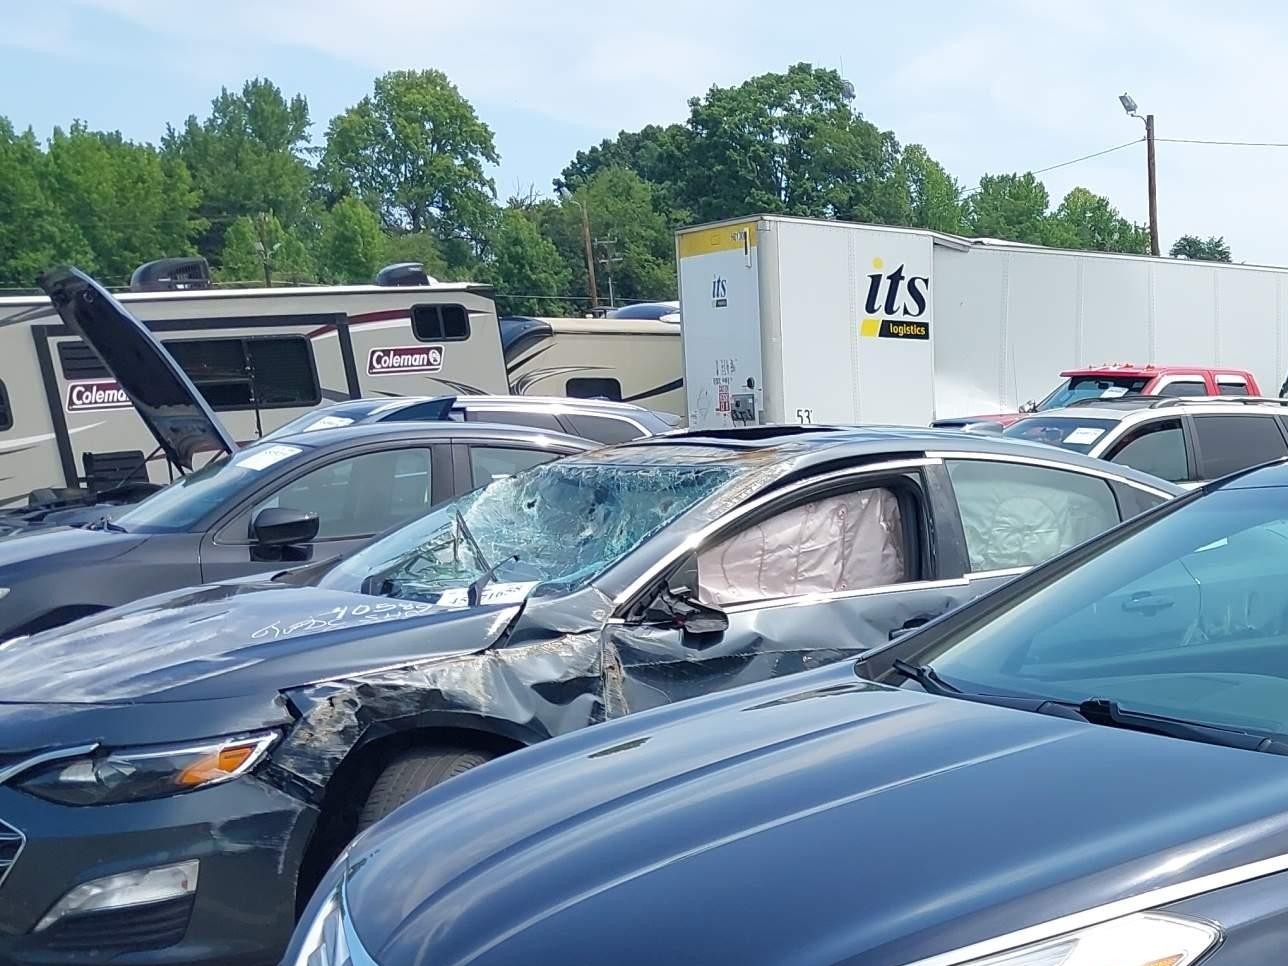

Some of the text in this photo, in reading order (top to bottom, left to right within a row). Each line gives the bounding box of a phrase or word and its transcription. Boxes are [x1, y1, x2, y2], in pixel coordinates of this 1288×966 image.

[712, 274, 727, 298] its
[865, 257, 929, 317] its
[889, 323, 926, 336] logistics
[373, 351, 427, 368] Coleman
[72, 386, 130, 405] Colema
